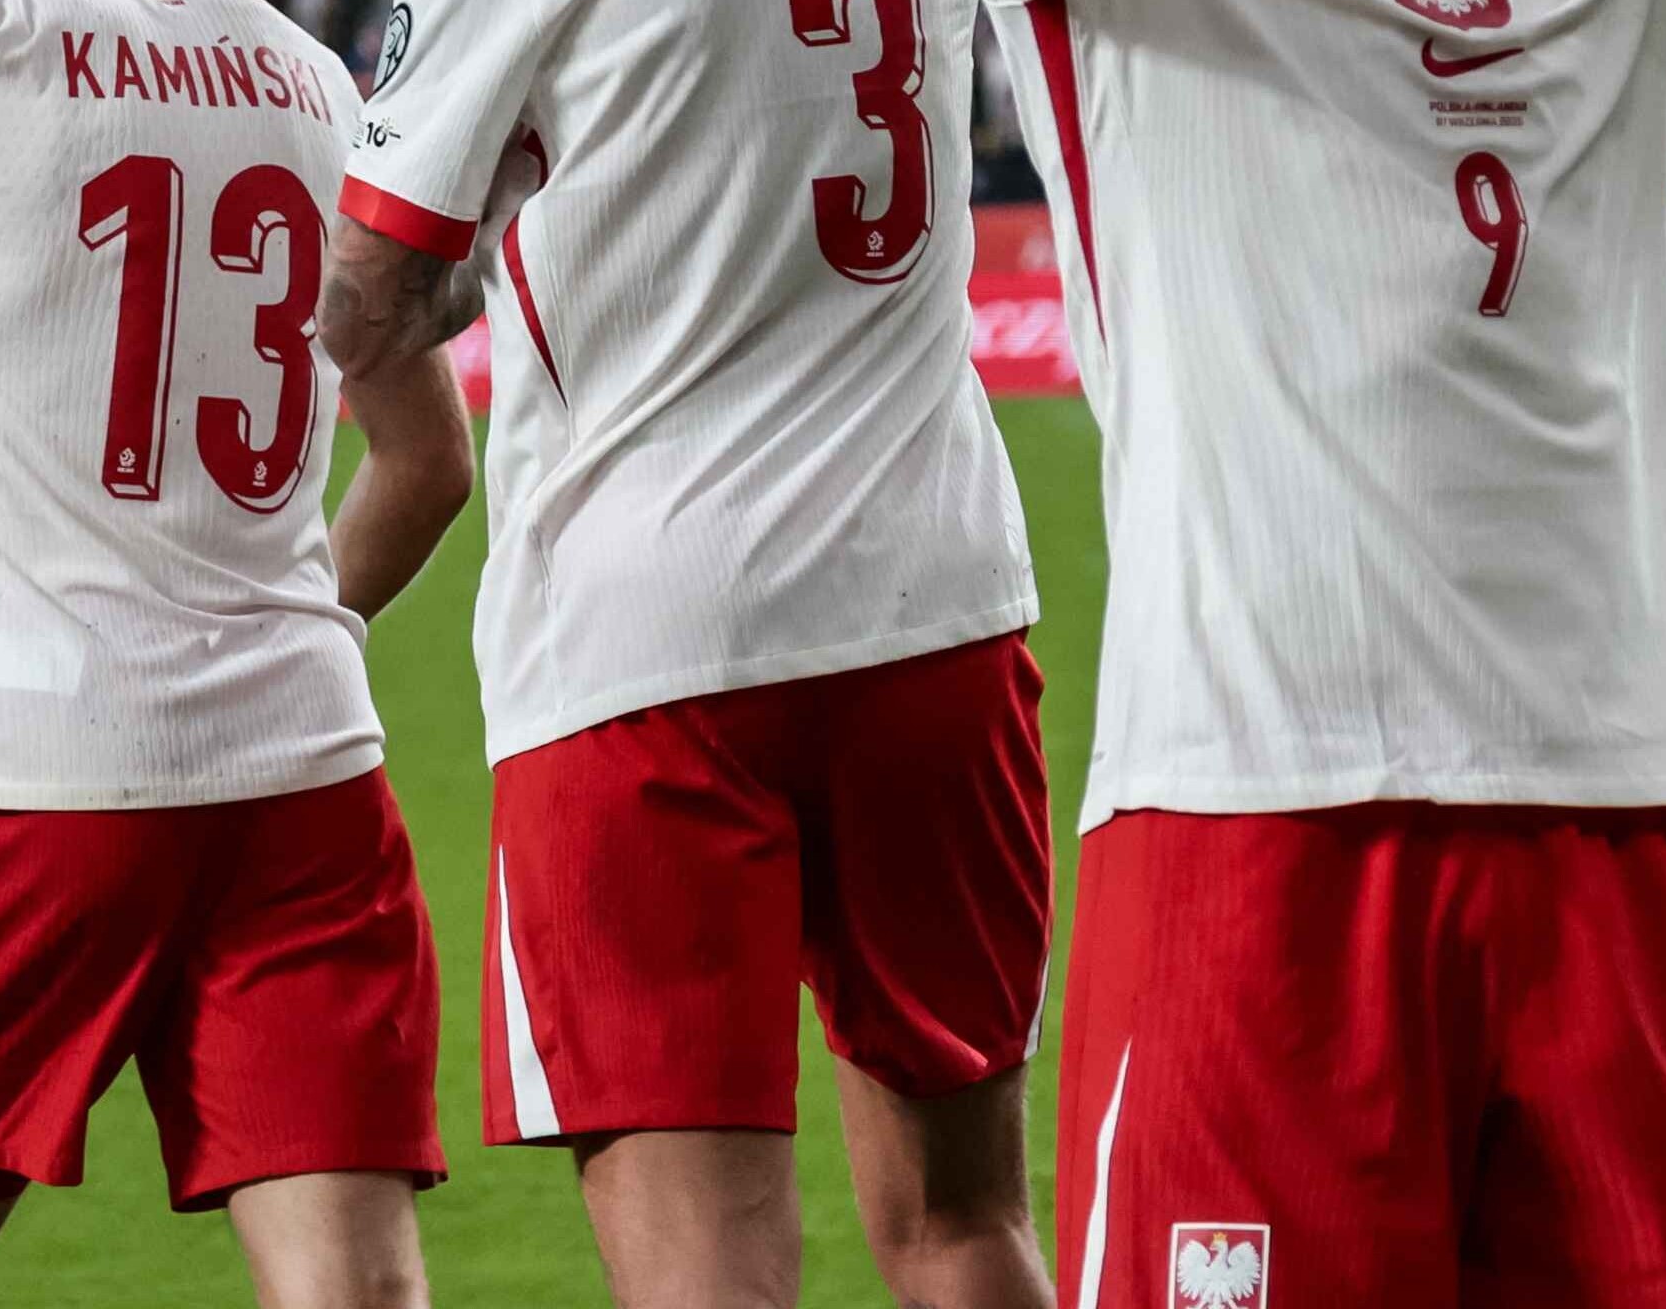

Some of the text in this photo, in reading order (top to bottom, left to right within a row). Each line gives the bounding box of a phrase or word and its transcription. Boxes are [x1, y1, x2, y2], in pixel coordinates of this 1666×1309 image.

[62, 31, 333, 126] KAMIŃSKI
[1455, 151, 1529, 318] 9
[79, 154, 328, 514] 13
